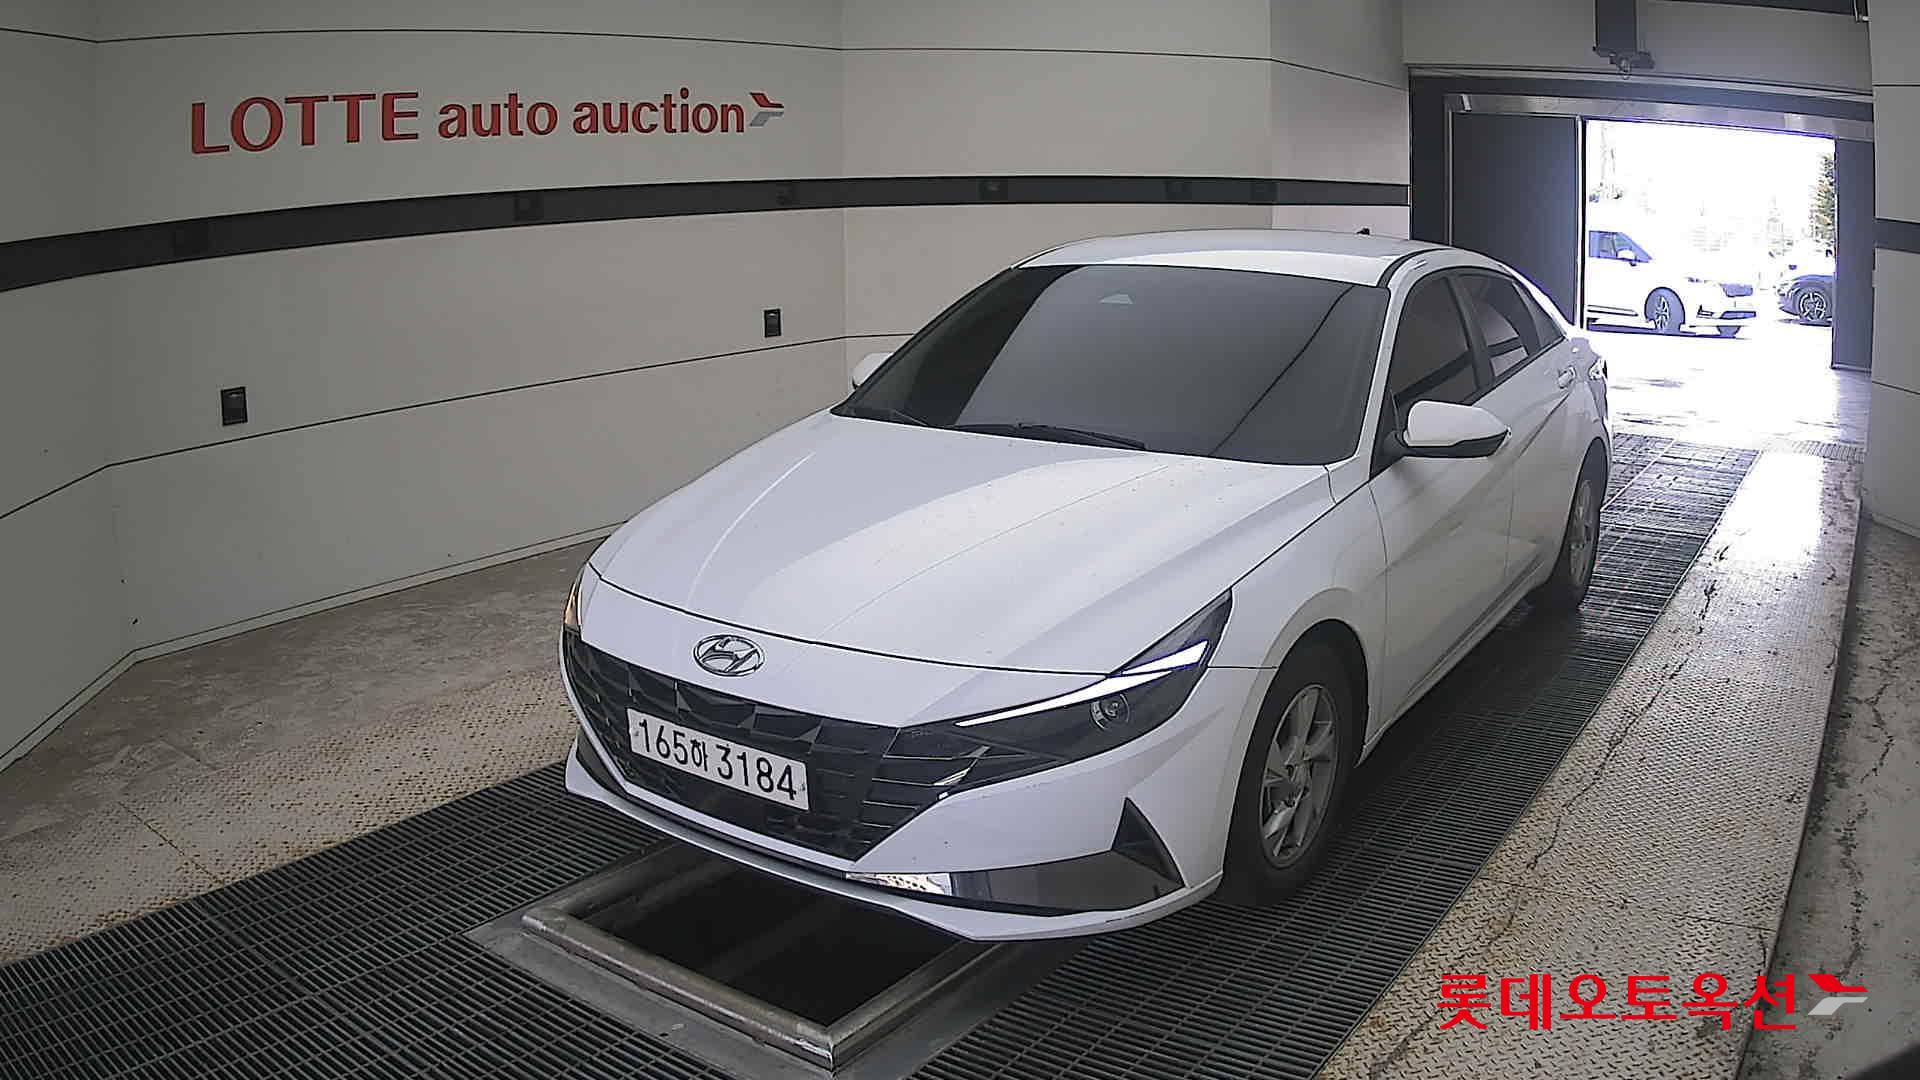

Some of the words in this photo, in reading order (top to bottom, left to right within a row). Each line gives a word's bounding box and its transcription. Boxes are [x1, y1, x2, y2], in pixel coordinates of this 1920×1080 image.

[191, 92, 419, 155] LOTTE
[439, 93, 558, 139] auto
[573, 87, 746, 135] auction
